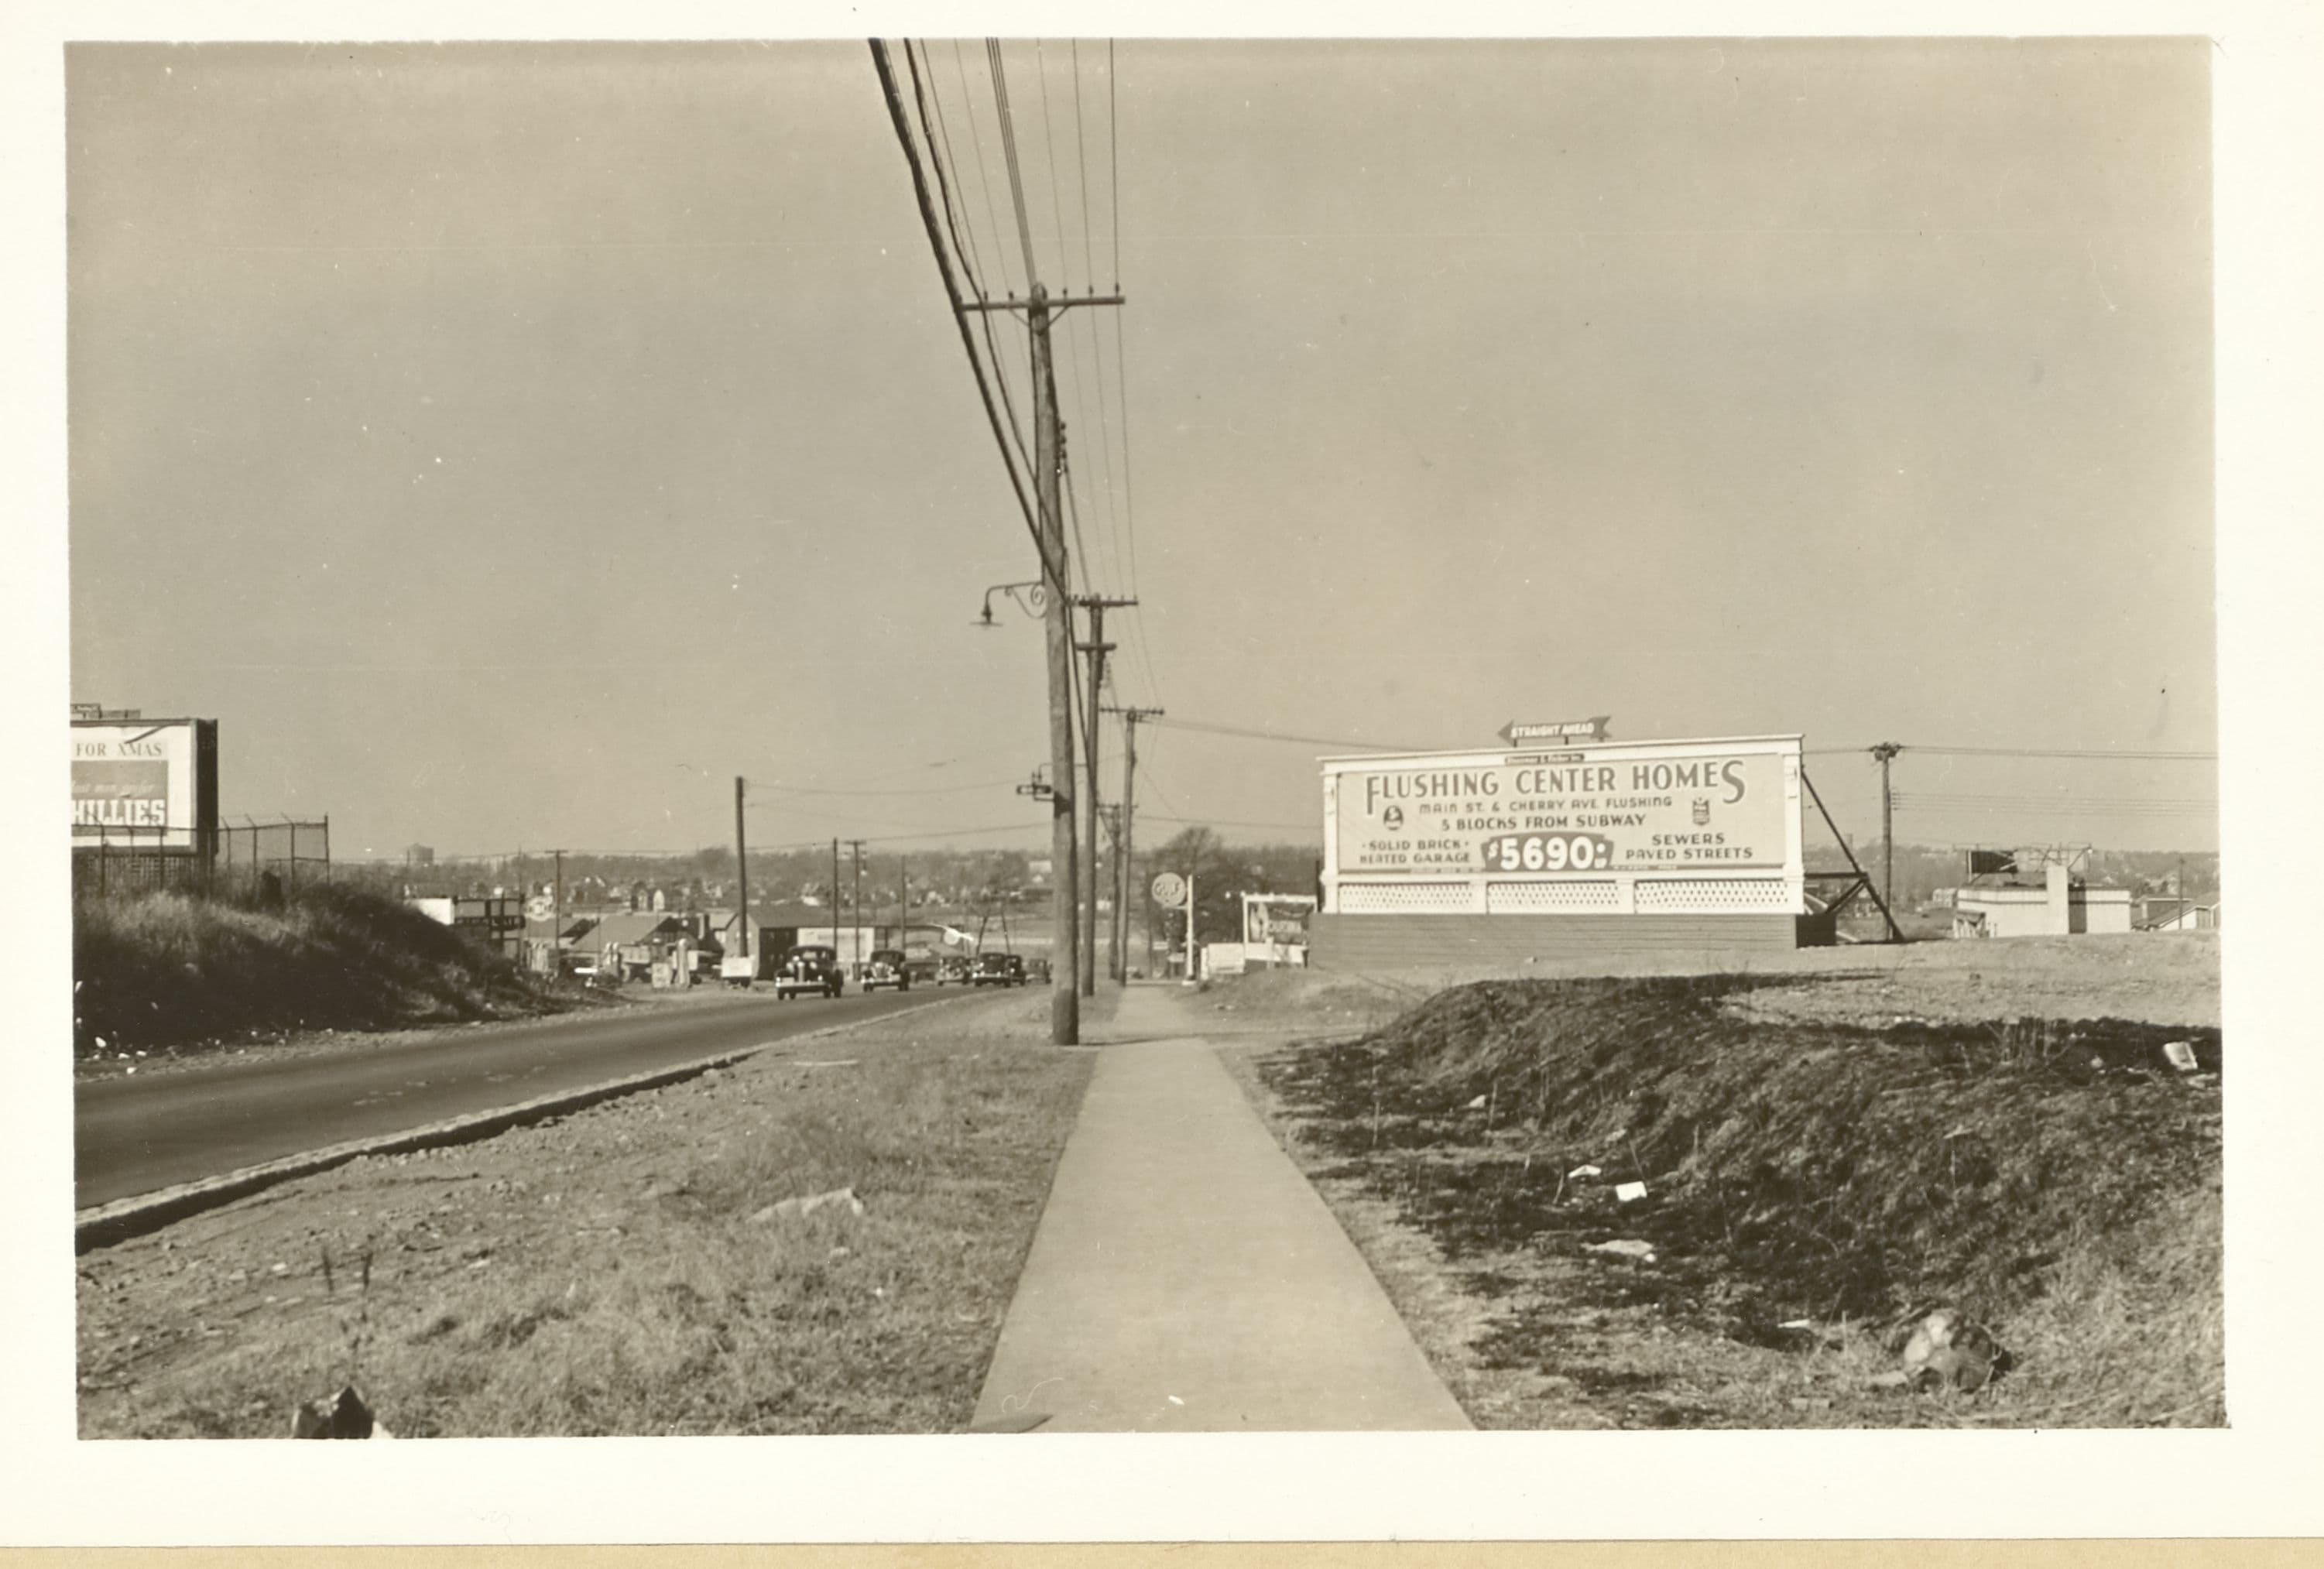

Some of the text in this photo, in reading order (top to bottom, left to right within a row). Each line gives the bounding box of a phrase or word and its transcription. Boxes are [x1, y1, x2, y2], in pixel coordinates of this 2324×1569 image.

[1510, 722, 1596, 738] STRAIGHT AHEAD
[76, 742, 163, 757] FOR XMAS
[1366, 759, 1746, 815] FLUSHING CENTER HOMES
[1492, 801, 1500, 812] &
[1509, 798, 1565, 812] CHERRY
[1606, 796, 1672, 809] FLUSHING
[1442, 813, 1647, 831] 5 BLOCKS FROM SUBWAY
[1369, 838, 1461, 851] SOLID BRICK
[1651, 832, 1725, 846] SEWERS
[1414, 852, 1469, 864] GARAGE
[1626, 846, 1753, 860] PAVED STREETS
